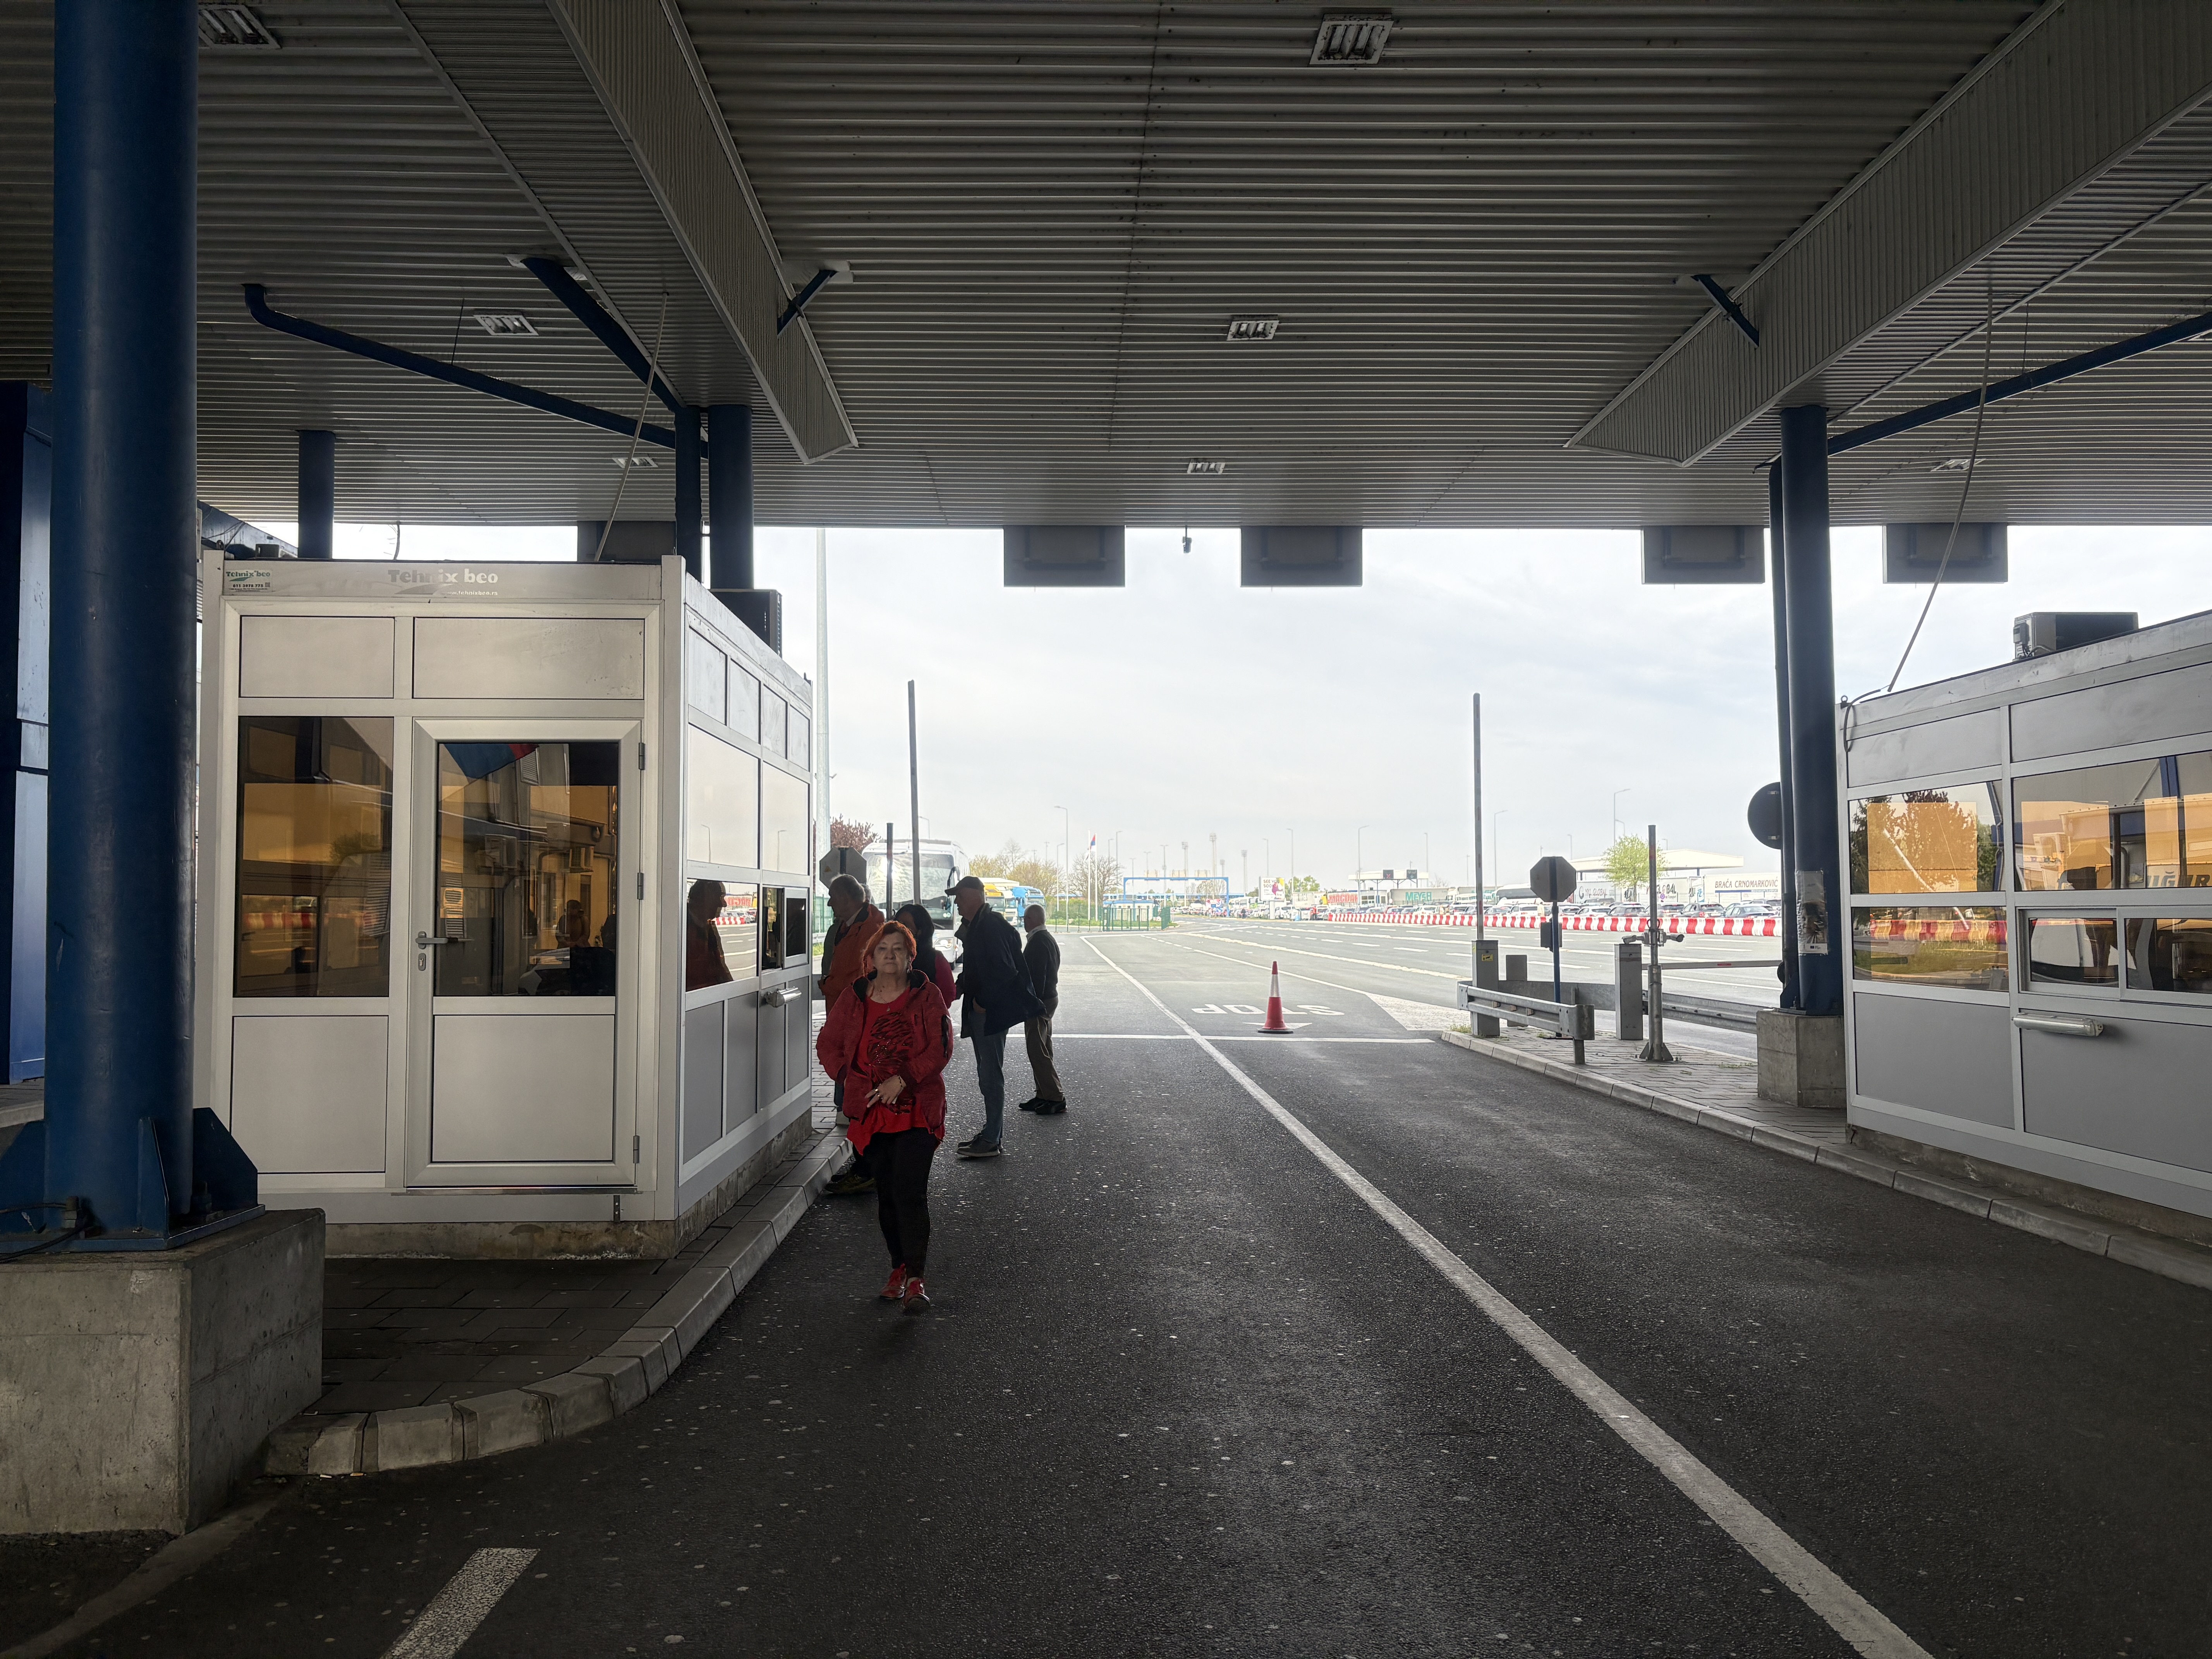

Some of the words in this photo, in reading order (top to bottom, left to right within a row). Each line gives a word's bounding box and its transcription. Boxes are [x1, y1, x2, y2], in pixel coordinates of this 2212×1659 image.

[388, 569, 459, 583] Tehnix
[464, 568, 498, 583] beo
[1715, 879, 1732, 888] BRAĆA
[1735, 877, 1778, 888] CRNOMARKOVIĆ
[1191, 1004, 1345, 1015] STOP
